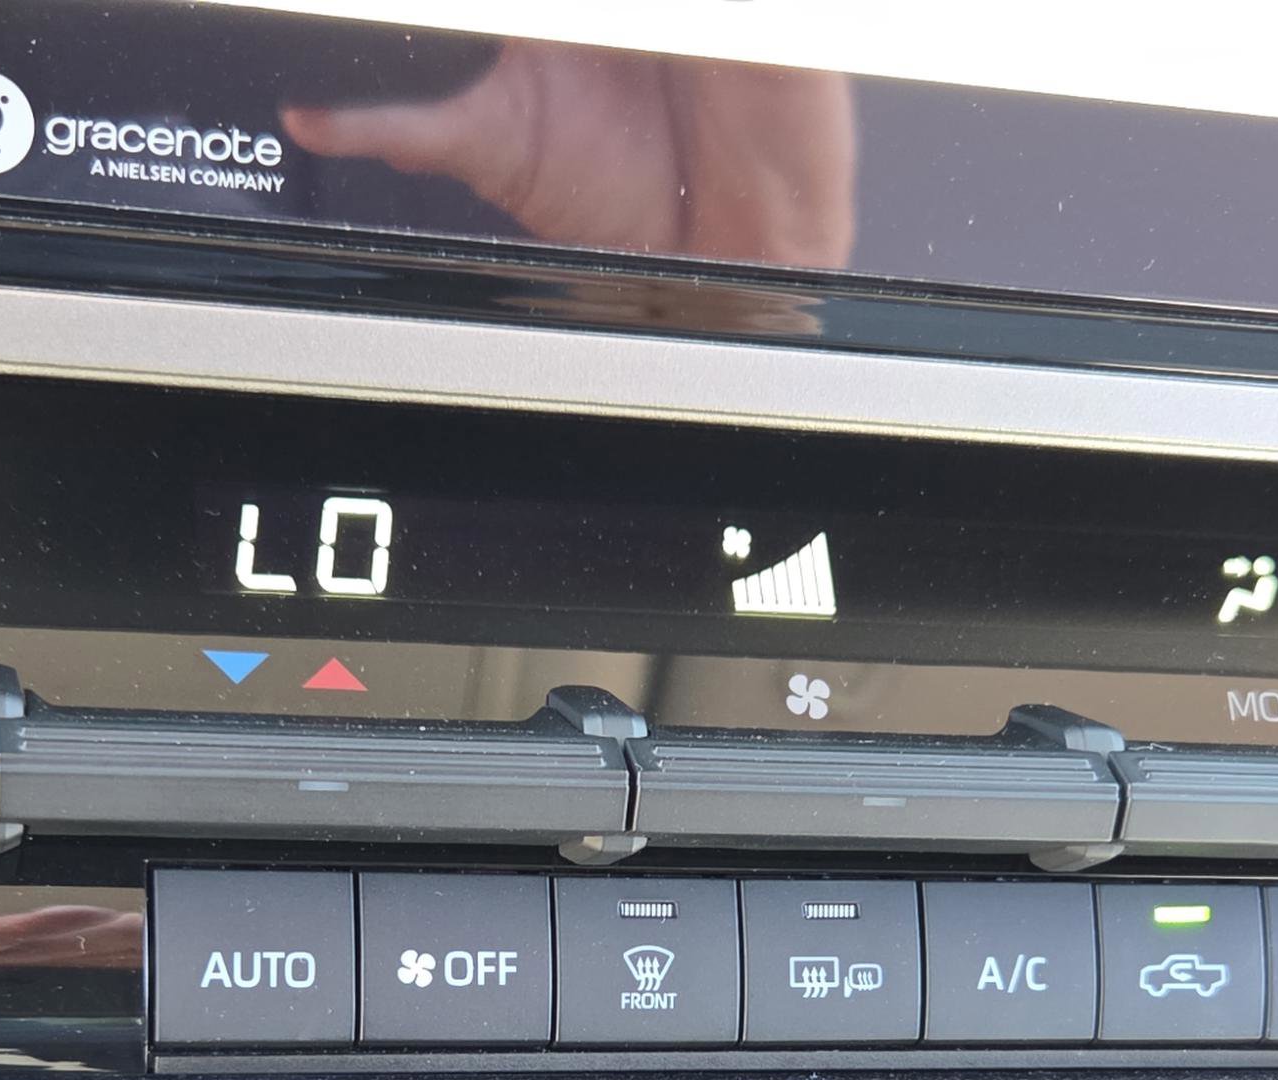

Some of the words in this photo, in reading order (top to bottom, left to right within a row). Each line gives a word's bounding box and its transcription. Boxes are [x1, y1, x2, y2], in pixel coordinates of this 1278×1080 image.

[45, 116, 283, 167] gracenote
[90, 160, 105, 176] A
[108, 162, 186, 184] NIELSEN
[190, 169, 285, 193] COMPANY
[235, 496, 393, 600] LO
[200, 951, 316, 989] AUTO
[444, 950, 518, 987] OFF
[976, 954, 1047, 994] A/C
[620, 992, 678, 1010] FRONT
